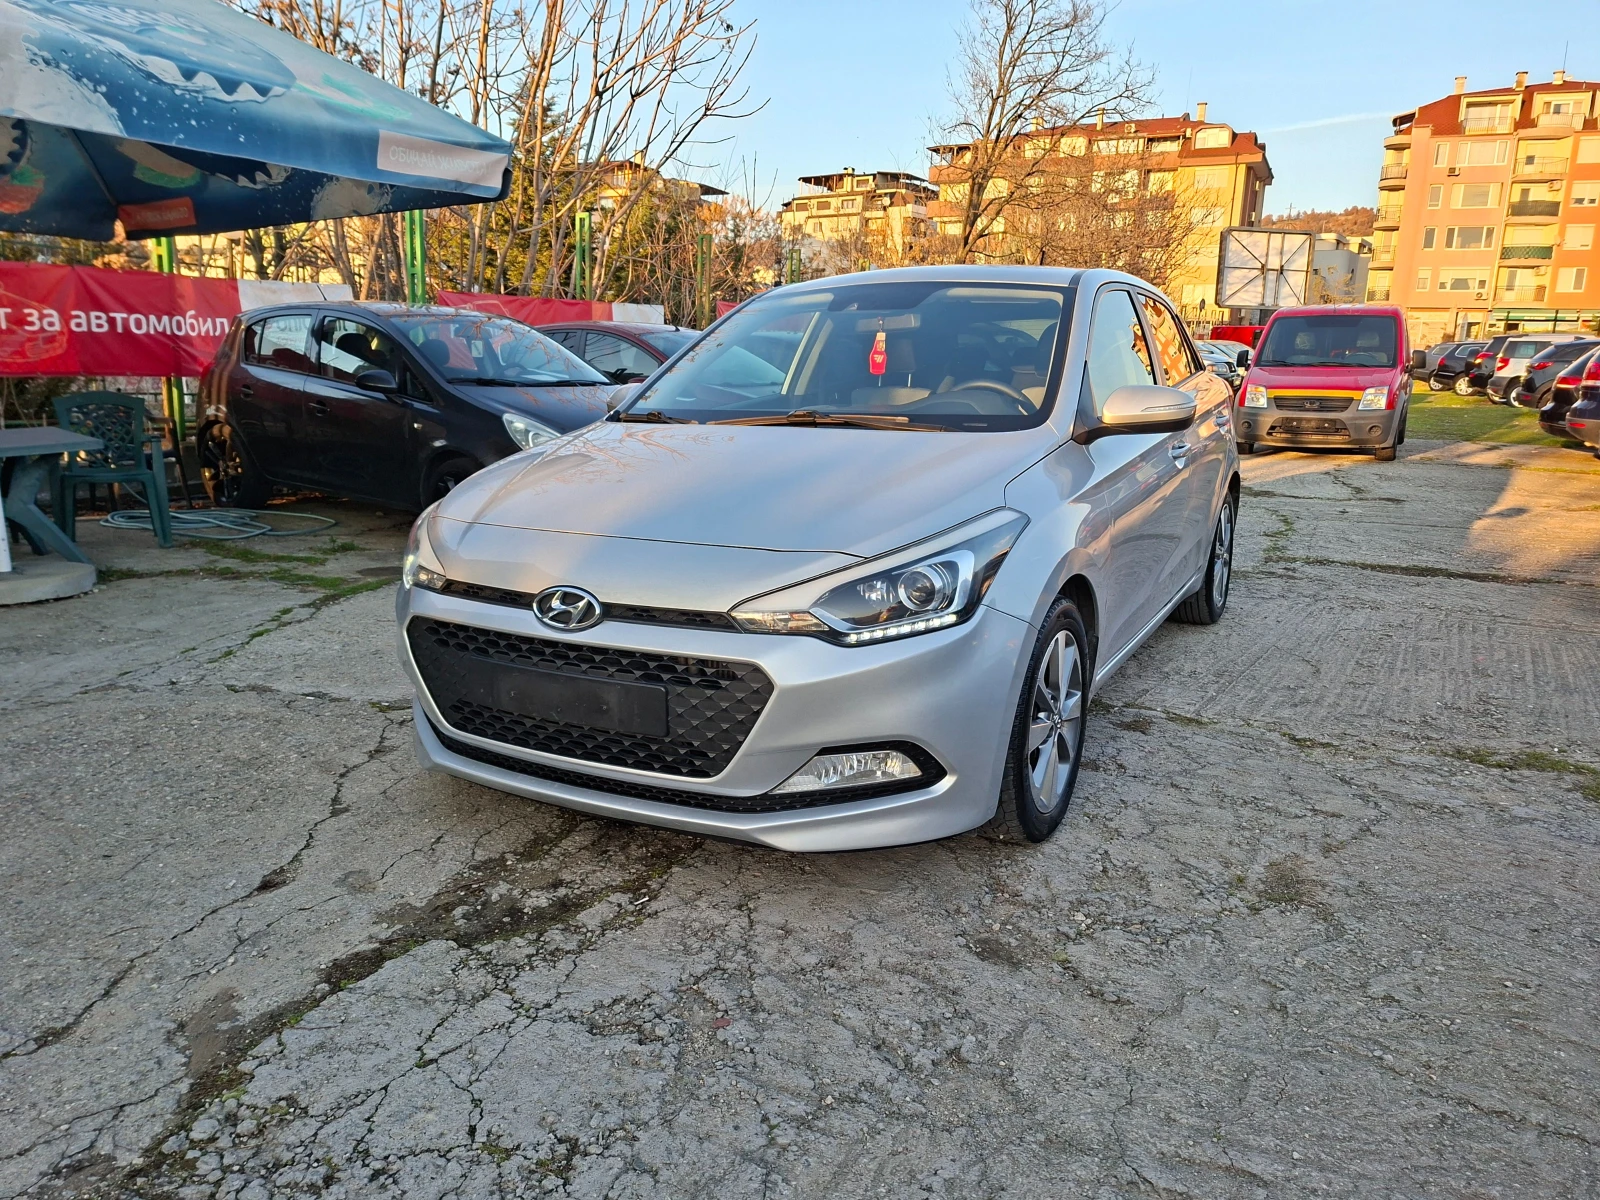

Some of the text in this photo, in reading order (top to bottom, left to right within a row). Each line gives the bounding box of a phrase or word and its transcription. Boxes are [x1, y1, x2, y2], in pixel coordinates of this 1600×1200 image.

[389, 145, 437, 168] ОБИЧАЙ
[23, 309, 61, 332] за
[70, 310, 229, 337] автомобил
